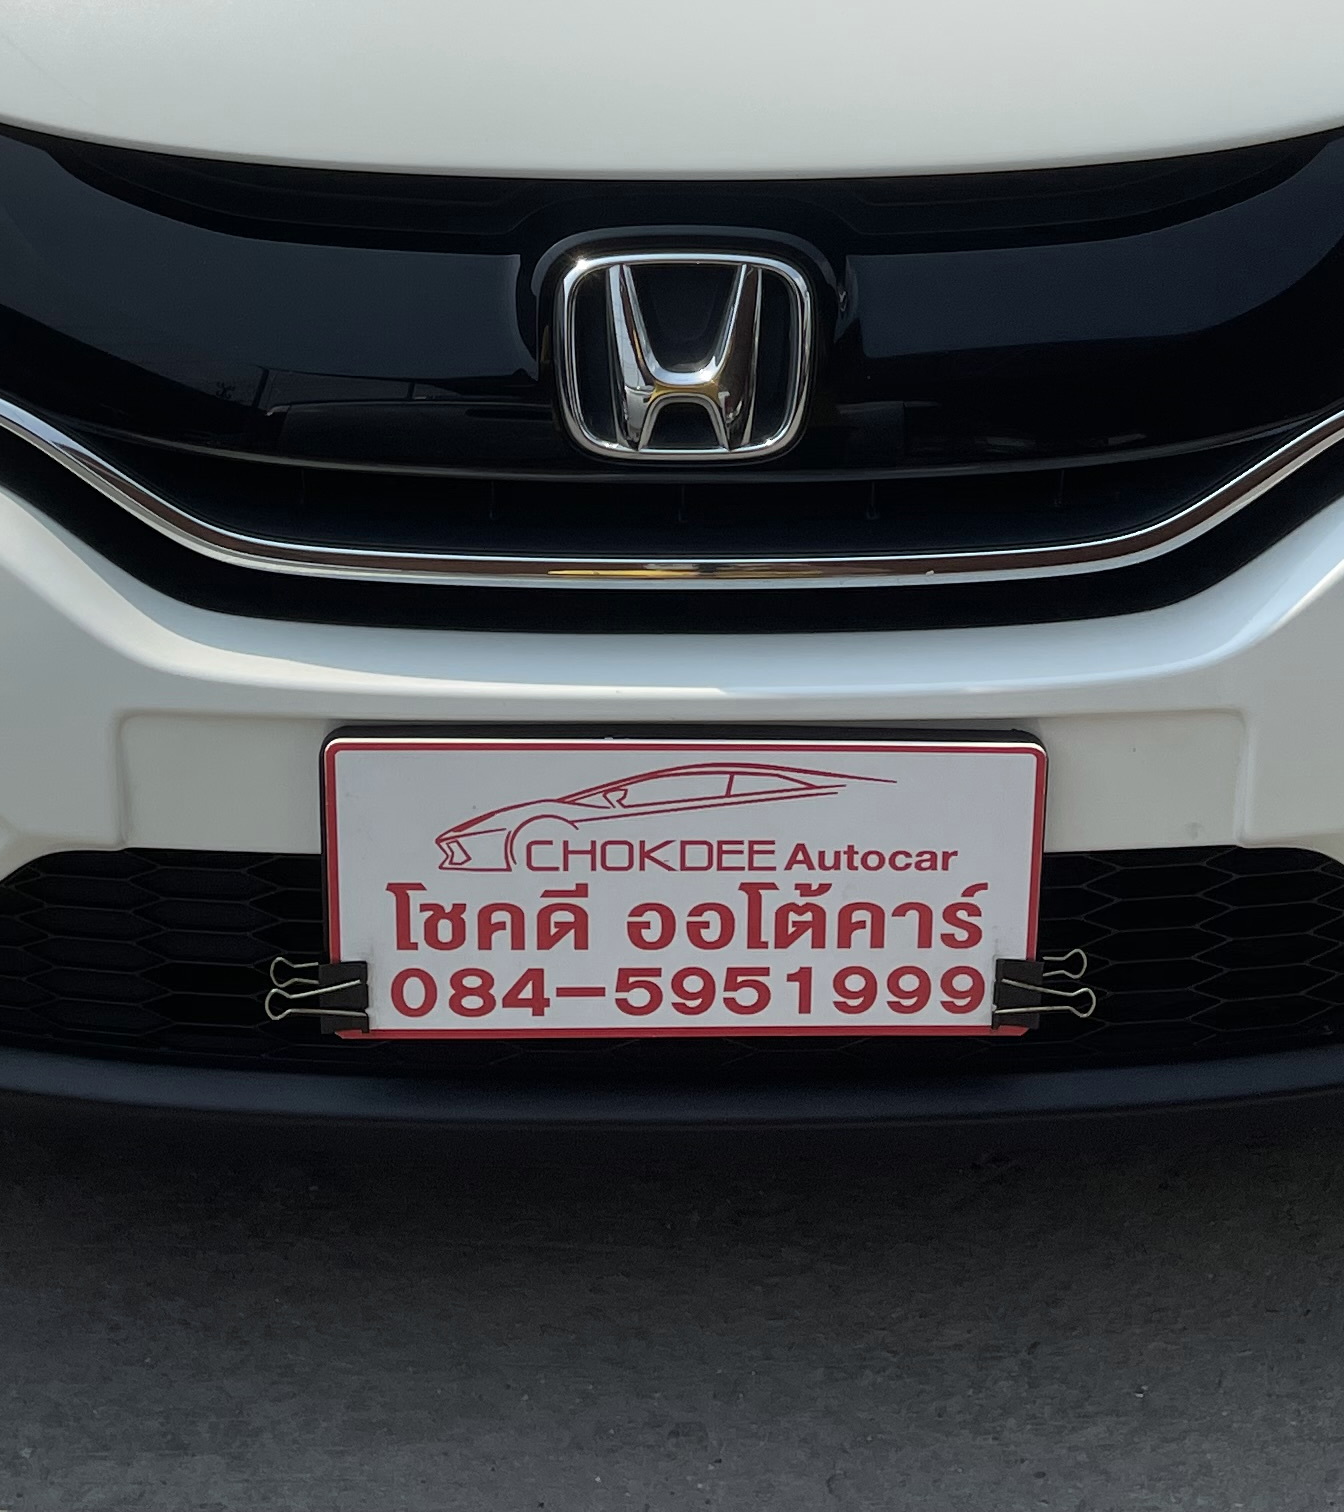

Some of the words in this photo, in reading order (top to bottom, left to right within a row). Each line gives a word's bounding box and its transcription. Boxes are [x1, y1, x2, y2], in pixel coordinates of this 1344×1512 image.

[525, 839, 777, 873] CHOKDEE
[784, 843, 959, 872] Autocar
[386, 881, 590, 952] โชคดี
[626, 881, 989, 952] ออโต้คาร์
[390, 964, 986, 1019] 084-5951999
